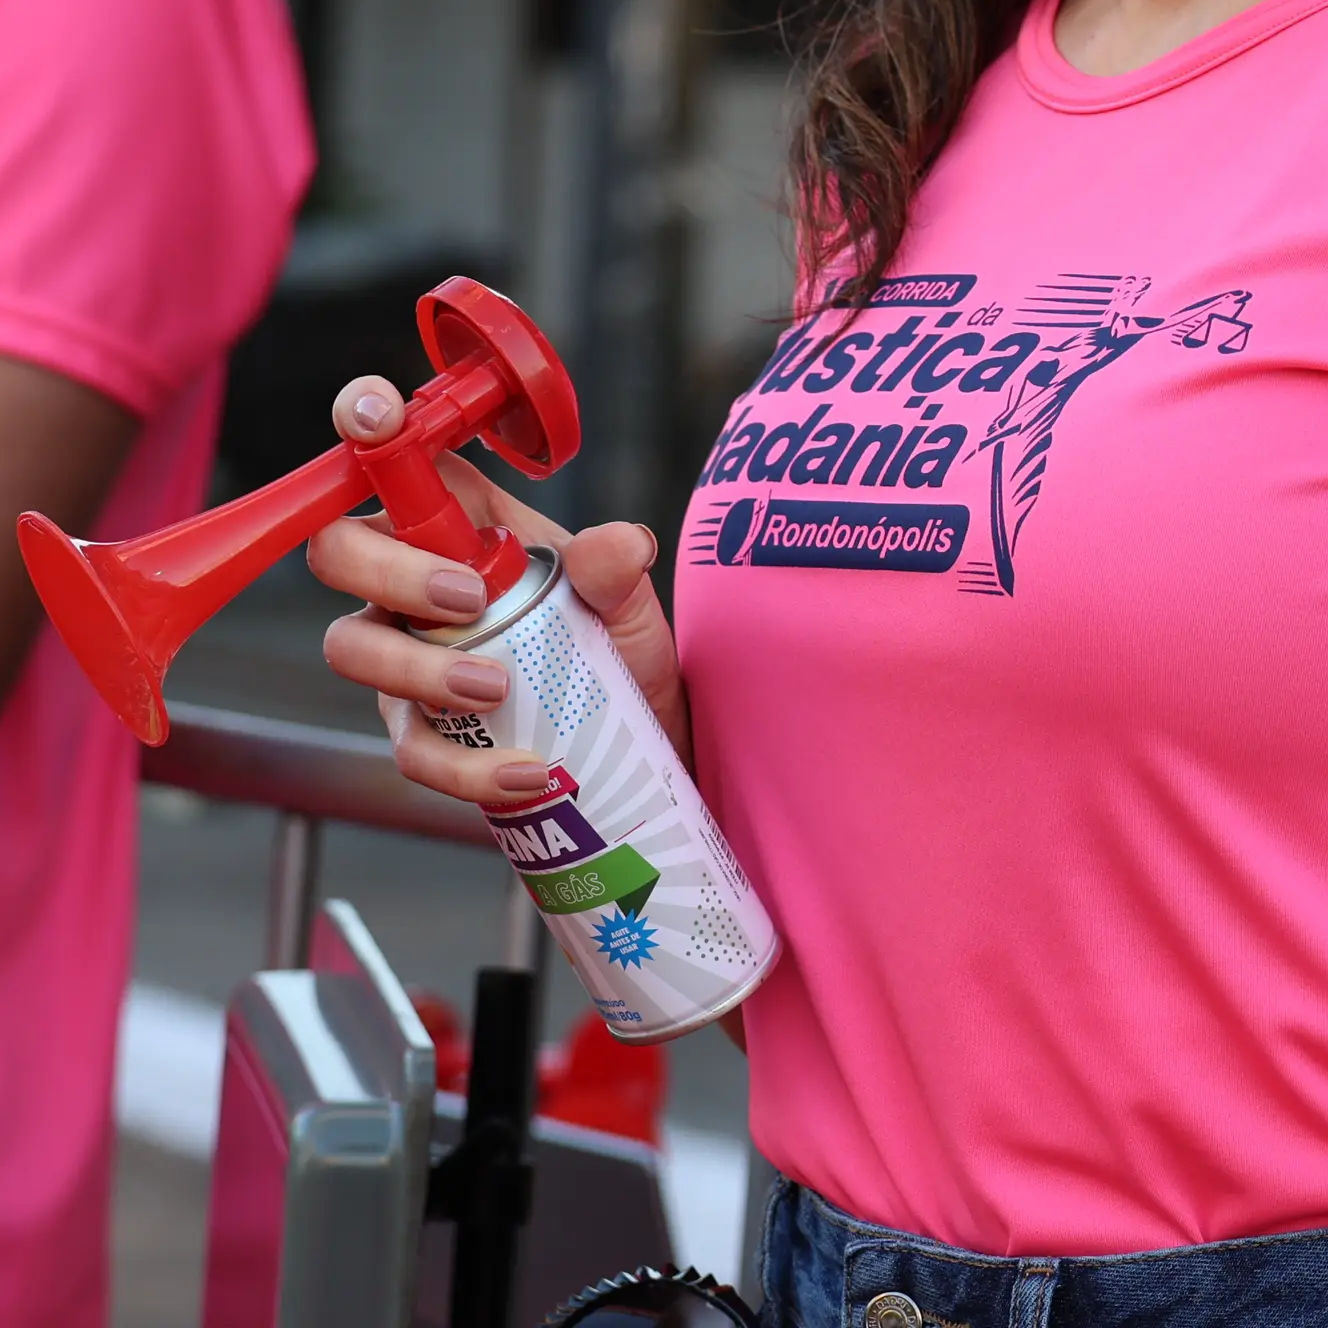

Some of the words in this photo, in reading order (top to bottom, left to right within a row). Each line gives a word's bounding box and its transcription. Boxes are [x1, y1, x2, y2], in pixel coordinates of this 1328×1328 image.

[870, 280, 962, 304] CORRIDA
[966, 301, 1005, 327] da
[694, 396, 968, 491] dadania
[763, 514, 955, 558] Rondonópolis
[450, 713, 481, 731] DAS
[442, 728, 494, 748] TAS
[492, 817, 580, 863] ZINA
[536, 884, 558, 907] A
[555, 872, 606, 905] GÁS
[609, 936, 631, 950] ANTES
[630, 932, 641, 942] DE
[610, 926, 631, 940] AGITE
[619, 943, 639, 955] USAR
